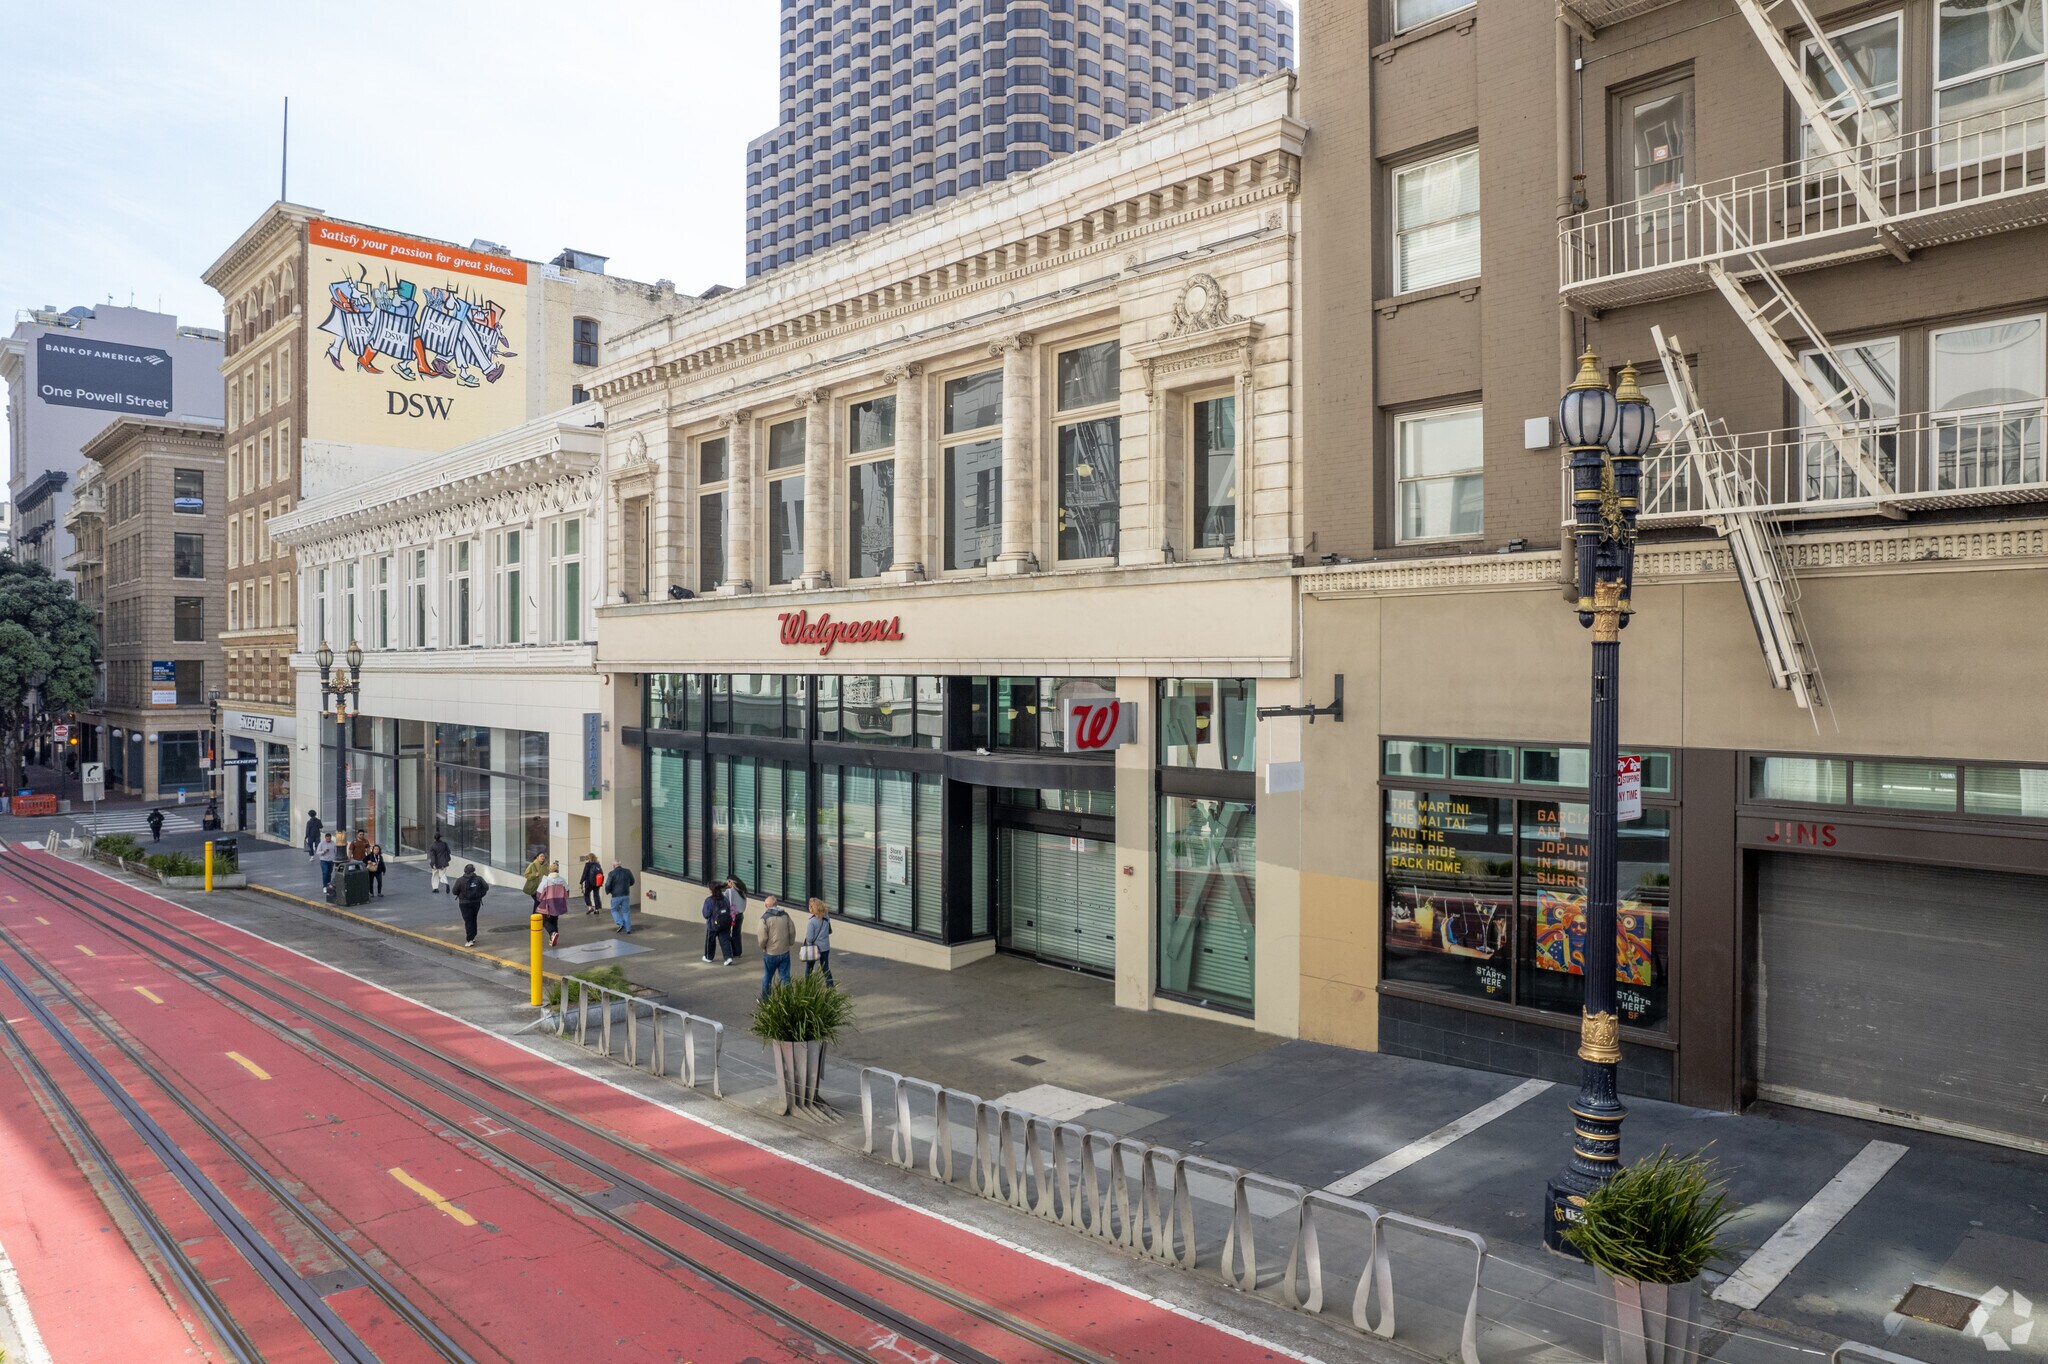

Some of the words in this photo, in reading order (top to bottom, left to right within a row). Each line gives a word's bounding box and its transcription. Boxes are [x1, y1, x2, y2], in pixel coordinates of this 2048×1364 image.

[320, 228, 360, 247] Satisfy
[361, 239, 388, 250] your
[390, 244, 432, 260] passion
[436, 252, 452, 263] for
[453, 258, 482, 269] great
[484, 262, 514, 276] shoes.
[428, 322, 447, 334] DSW
[385, 331, 405, 342] DSW
[45, 344, 76, 354] BANK
[78, 348, 92, 356] OF
[94, 351, 142, 363] AMERICA
[42, 385, 72, 397] One
[76, 388, 122, 404] Powell
[126, 394, 169, 409] Street
[386, 390, 454, 420] DSW
[778, 610, 904, 656] Walgreens
[240, 716, 273, 732] SKECHERS
[1071, 700, 1120, 750] W
[589, 714, 598, 786] PHARMACY
[1622, 774, 1640, 784] STOPPING
[1618, 791, 1626, 801] NY
[1626, 789, 1638, 801] TIME
[1391, 798, 1414, 810] THE
[1418, 801, 1472, 815] MARTINI.
[1391, 812, 1414, 825] THE
[1418, 815, 1440, 827] MAI
[1445, 817, 1469, 830] TAI.
[1391, 828, 1417, 839] AND
[1420, 829, 1445, 842] THE
[1537, 825, 1567, 839] AND
[890, 847, 902, 856] Store
[1391, 841, 1423, 854] UBER
[1427, 845, 1456, 858] RIDE
[1537, 841, 1589, 857] JOPLIN
[1391, 855, 1423, 869] BACK
[1427, 860, 1465, 874] HOME.
[1537, 856, 1551, 868] IN
[1537, 872, 1585, 889] SURRO
[1476, 966, 1506, 980] STARTS
[1481, 976, 1501, 987] HERE
[1486, 985, 1496, 994] SF
[1616, 990, 1651, 1006] STARTS
[1622, 1001, 1646, 1013] HERE
[1628, 1011, 1639, 1020] SF
